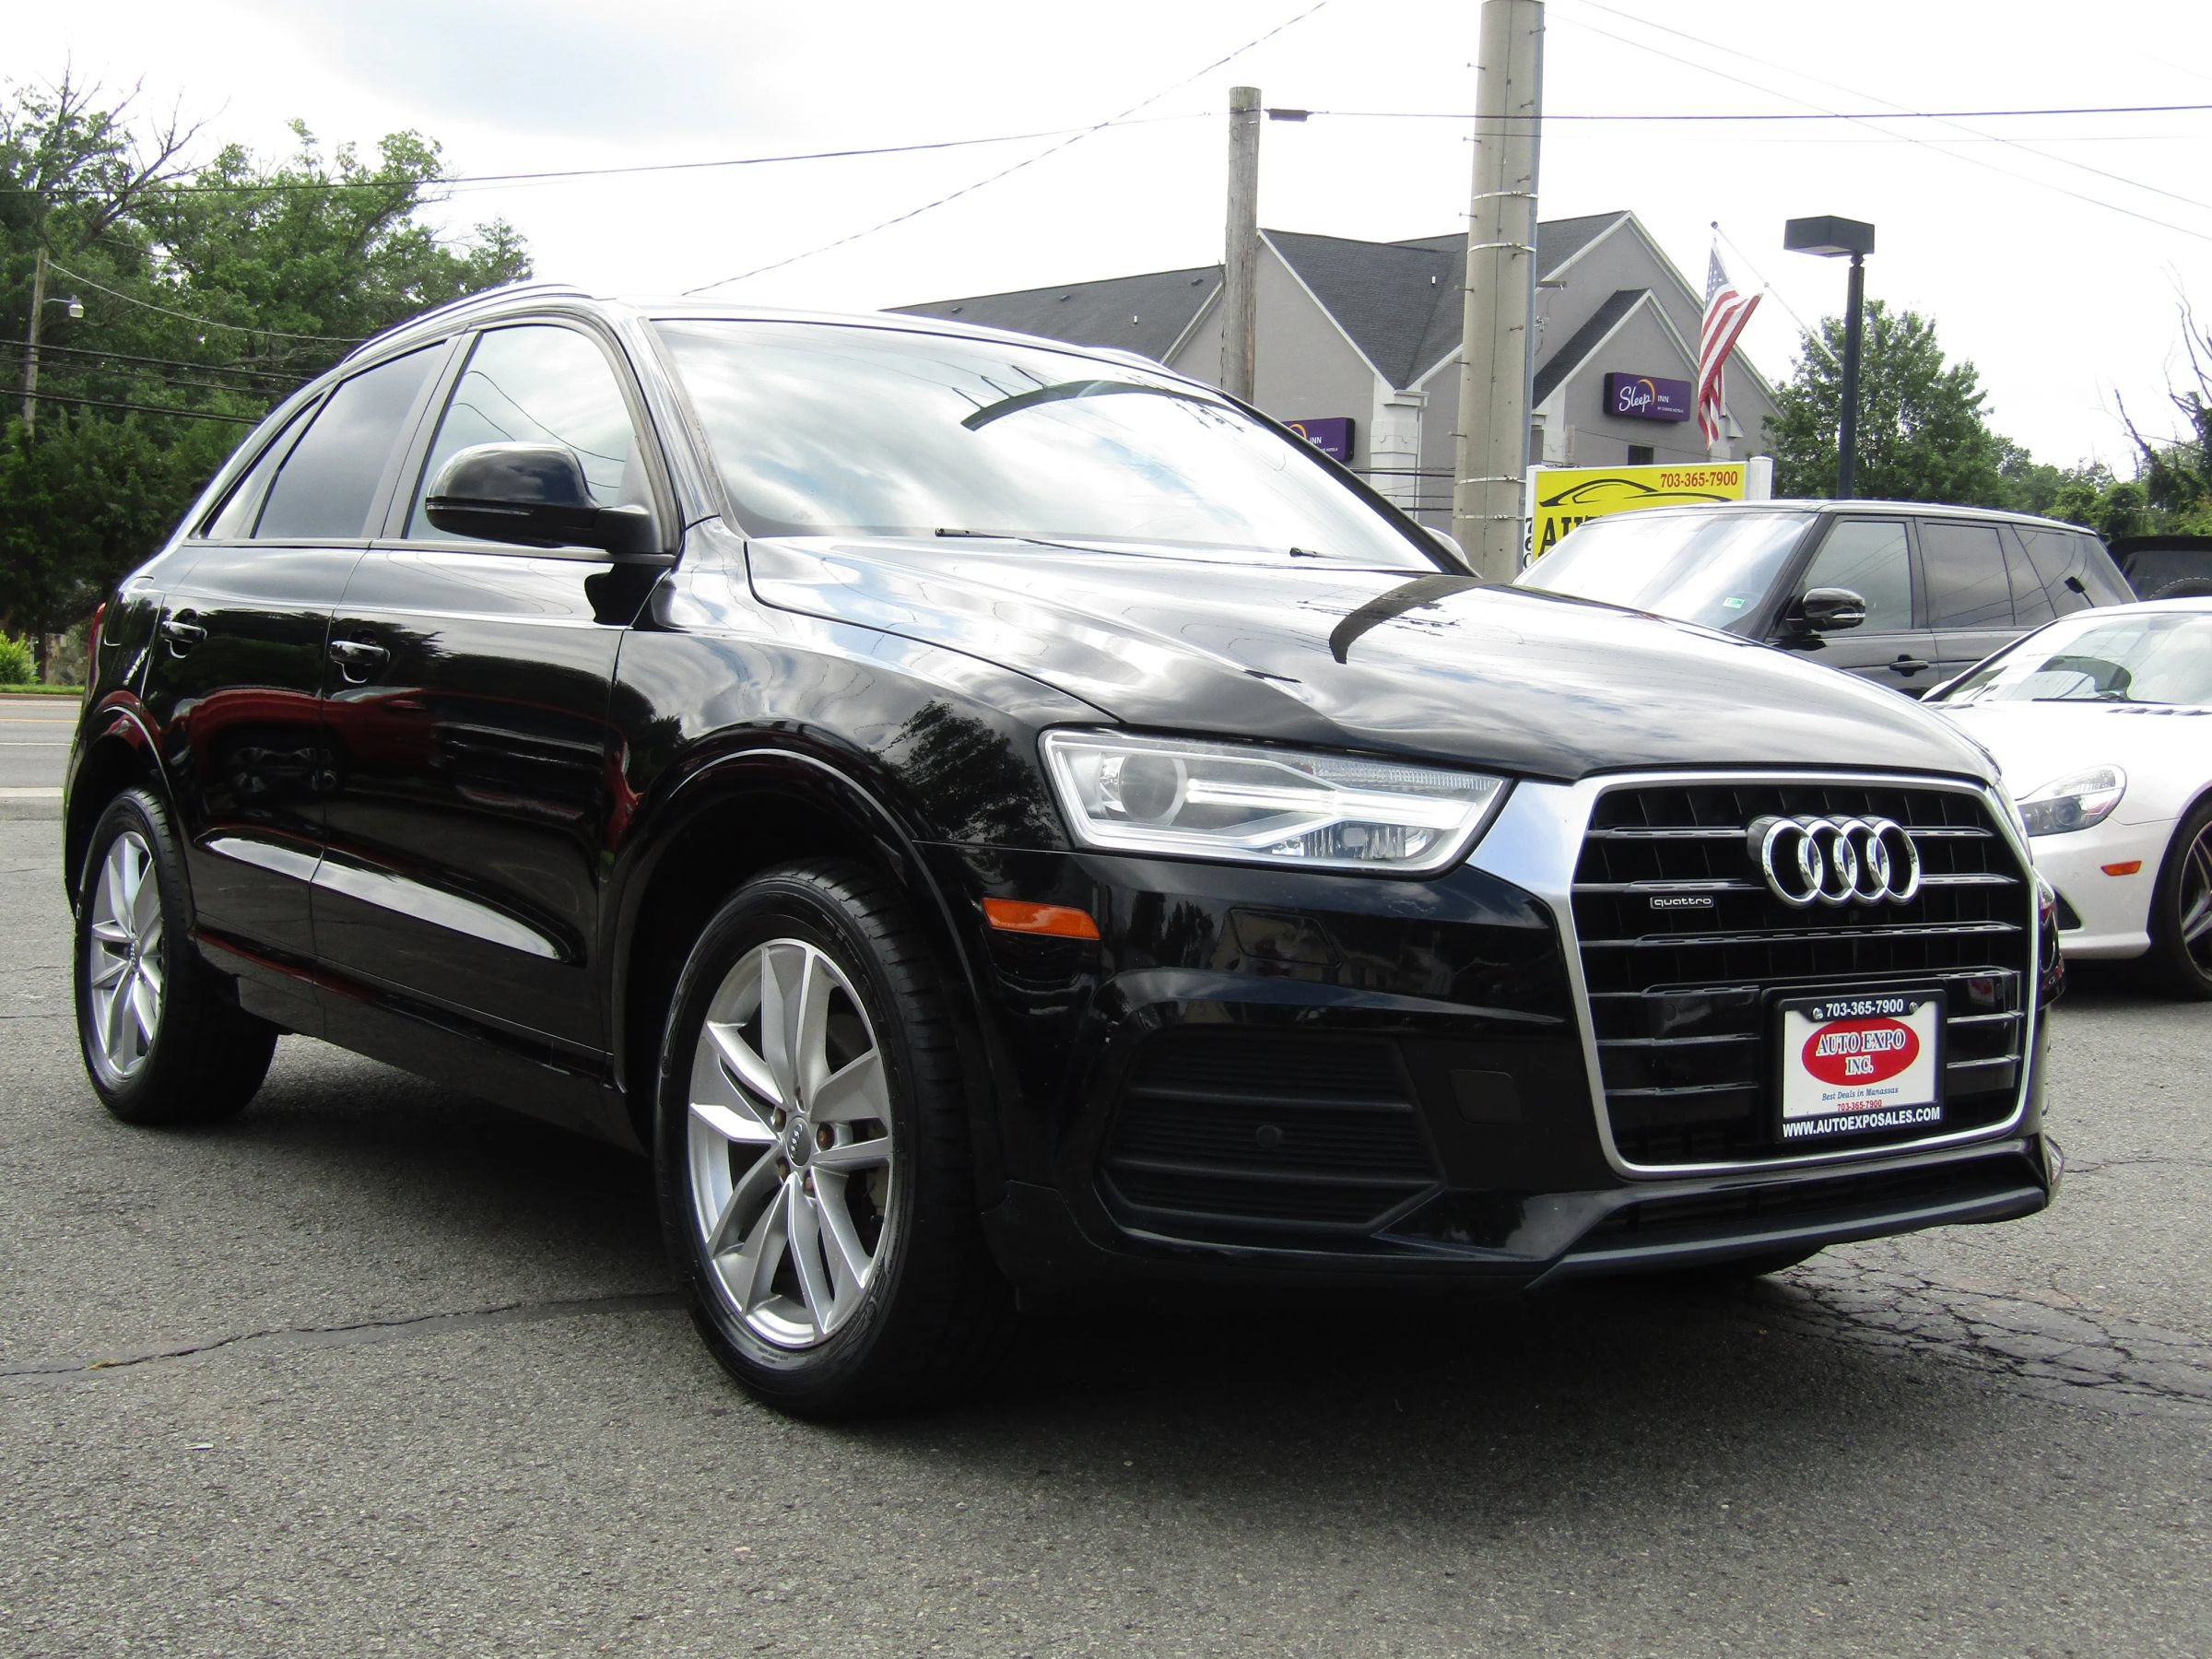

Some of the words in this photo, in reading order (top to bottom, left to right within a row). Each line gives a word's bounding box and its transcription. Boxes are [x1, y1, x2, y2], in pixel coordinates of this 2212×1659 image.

[1618, 386, 1652, 413] Sleep
[1657, 394, 1669, 403] INN
[1660, 471, 1738, 488] 703-365-7900
[1653, 897, 1712, 908] quattro
[1826, 999, 1904, 1018] 703-365-7900
[1816, 1033, 1860, 1056] AUTO
[1862, 1029, 1906, 1052] EXPO
[1845, 1055, 1874, 1076] INC.
[1821, 1092, 1836, 1101] Best
[1837, 1089, 1855, 1100] Deals
[1857, 1088, 1864, 1097] in
[1865, 1087, 1899, 1097] Manassas
[1837, 1100, 1882, 1112] 703-365-7900
[1783, 1107, 1940, 1137] WWW.AUTOEXPOSALES.COM
